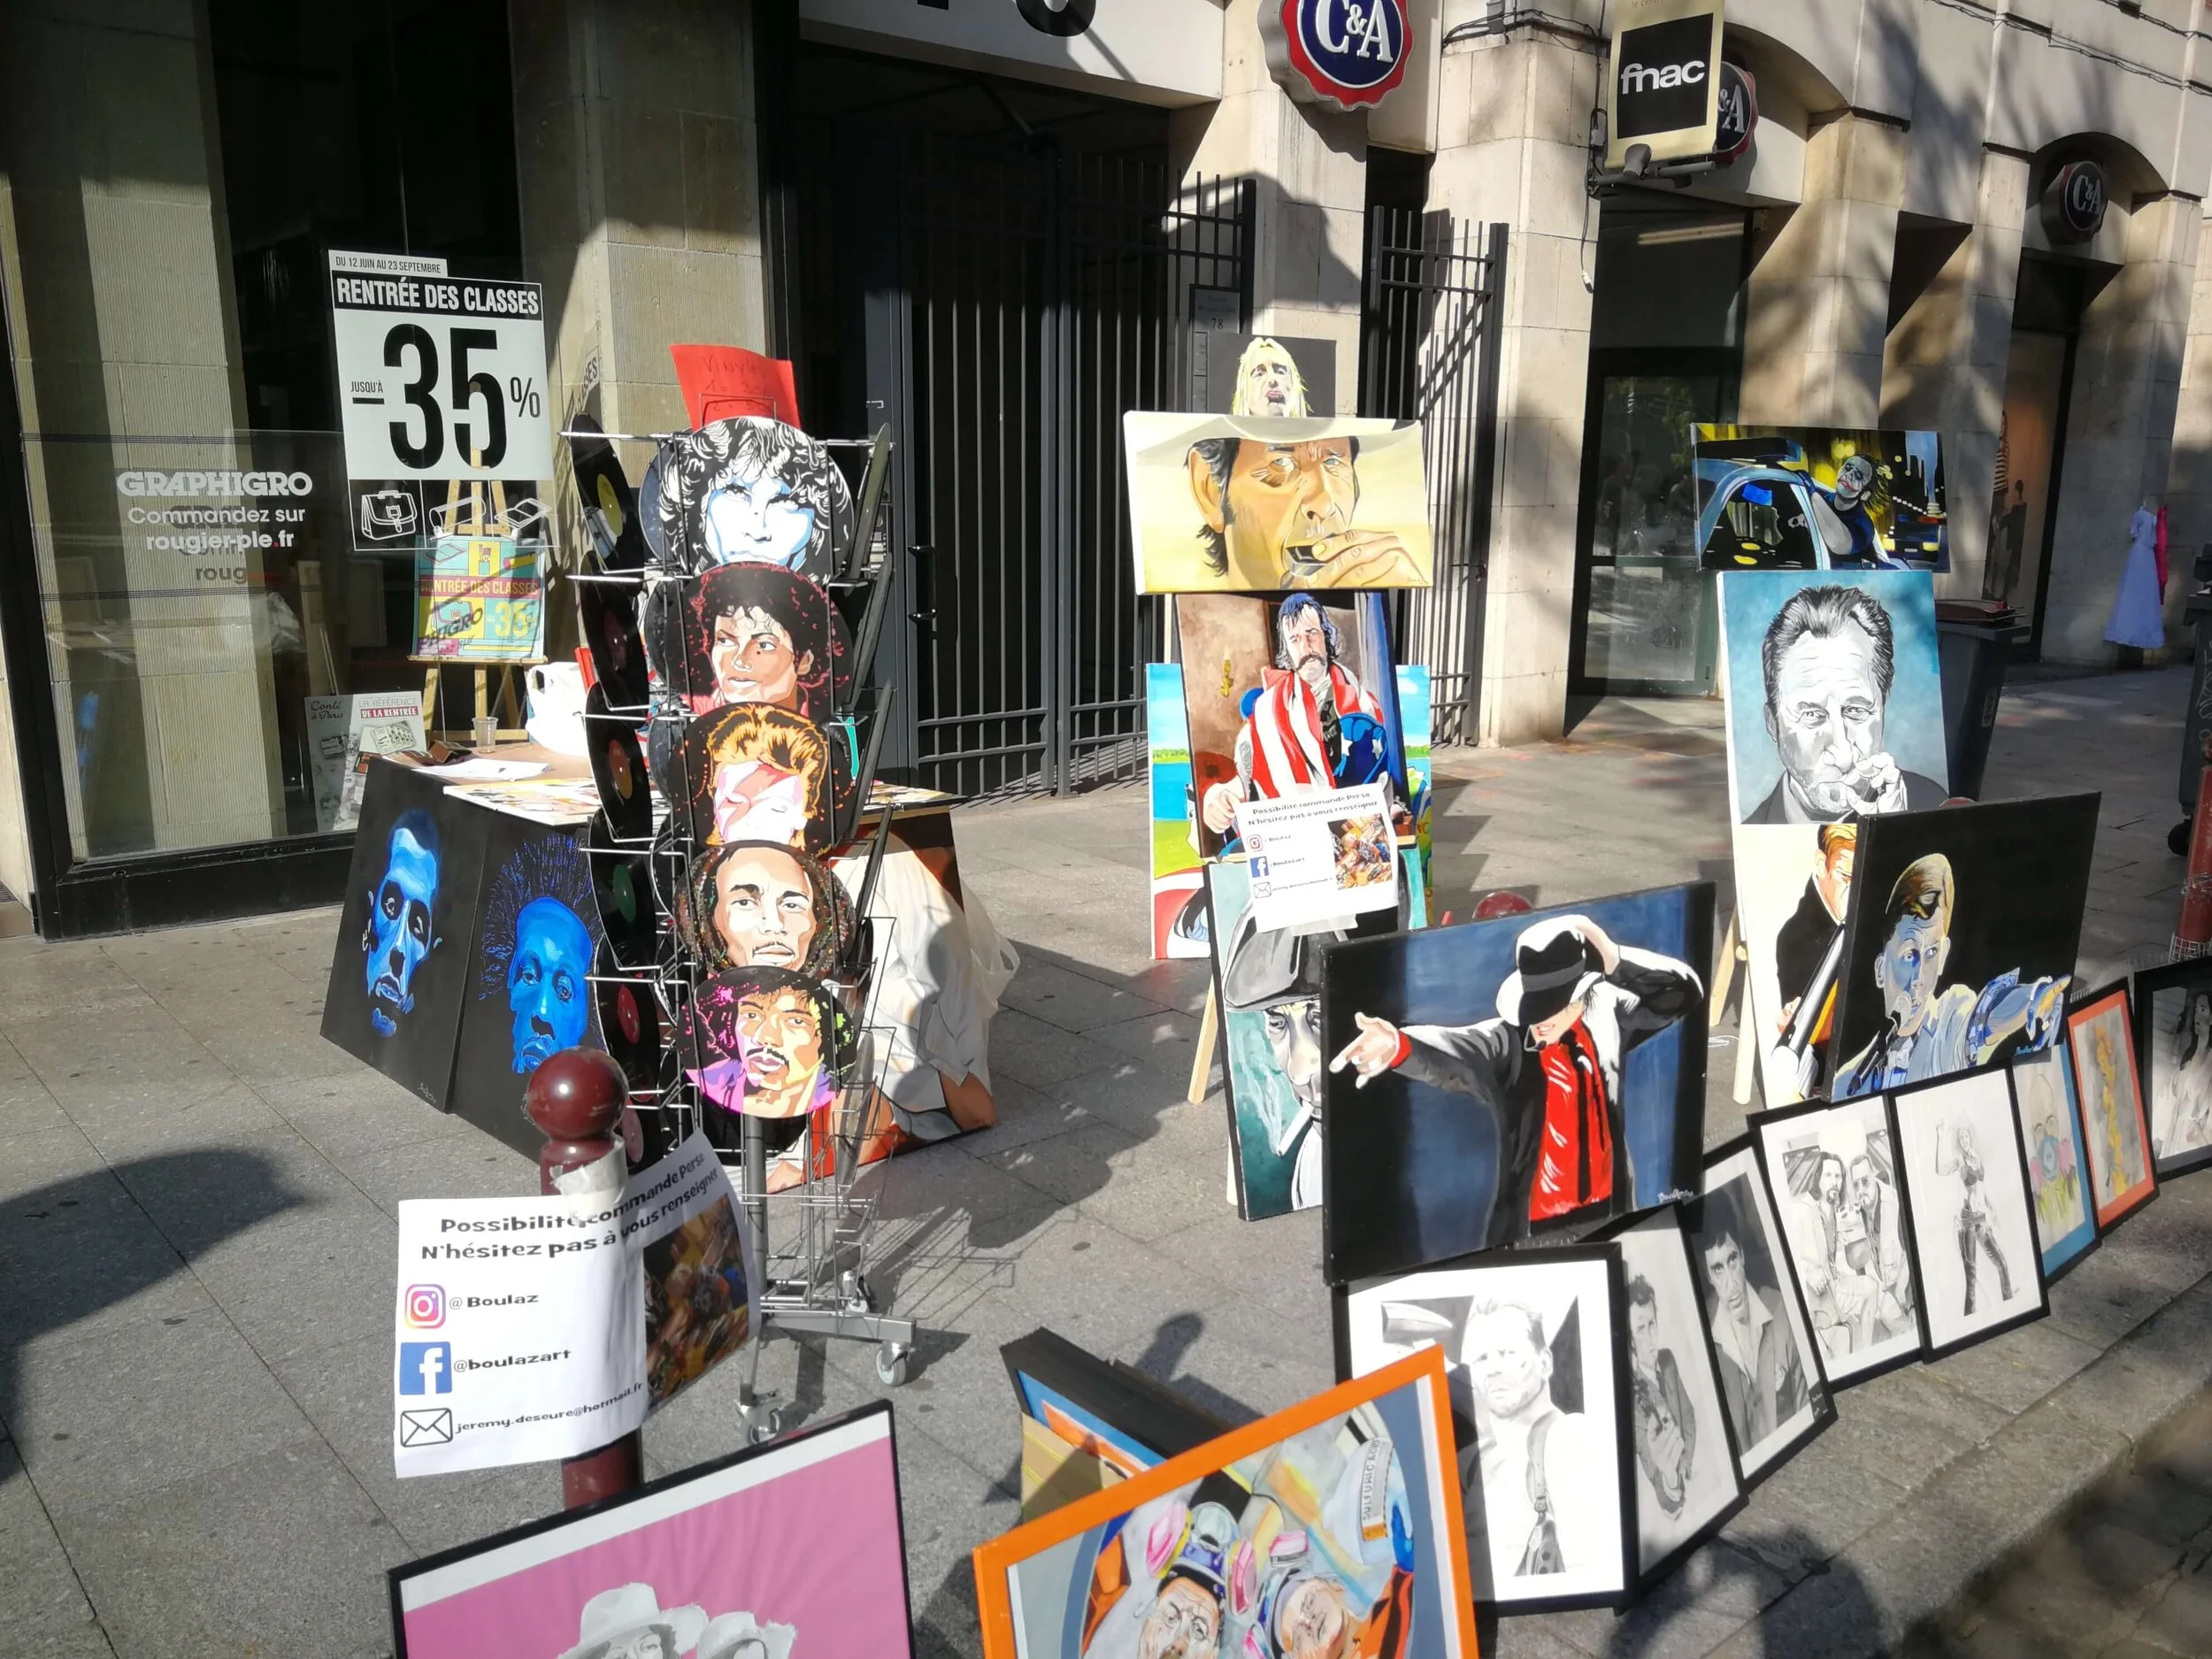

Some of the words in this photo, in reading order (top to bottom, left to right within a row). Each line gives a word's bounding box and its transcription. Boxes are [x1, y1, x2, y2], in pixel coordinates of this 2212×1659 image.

[1316, 0, 1394, 63] C&A
[1621, 60, 1705, 94] fnac
[1718, 85, 1745, 133] &A
[2073, 175, 2102, 213] C&A
[336, 256, 346, 266] DU
[349, 257, 357, 267] 12
[360, 258, 374, 269] JUIN
[377, 259, 387, 269] AU
[388, 260, 397, 271] 23
[399, 261, 441, 273] SEPTEMBRE
[336, 276, 421, 308] RENTRÉE
[425, 283, 459, 310] DES
[464, 287, 539, 315] CLASSES
[350, 380, 384, 393] JUSQU'À
[117, 472, 312, 496] GRAPHIGRO
[128, 507, 270, 524] Commandez
[275, 508, 305, 522] sur
[146, 530, 295, 555] rougier-ple.fr
[470, 580, 490, 595] DES
[492, 581, 539, 595] CLASSES
[384, 707, 417, 716] RENTRÉE
[1299, 795, 1346, 808] commande
[1334, 801, 1378, 812] renseigner
[587, 1174, 680, 1225] commande
[421, 1242, 542, 1260] N'hésitez
[549, 1236, 597, 1258] pas
[603, 1229, 617, 1246] à
[620, 1208, 659, 1237] vous
[661, 1167, 718, 1217] renseigner
[467, 1294, 539, 1308] Boulaz
[453, 1349, 572, 1372] @boulazart
